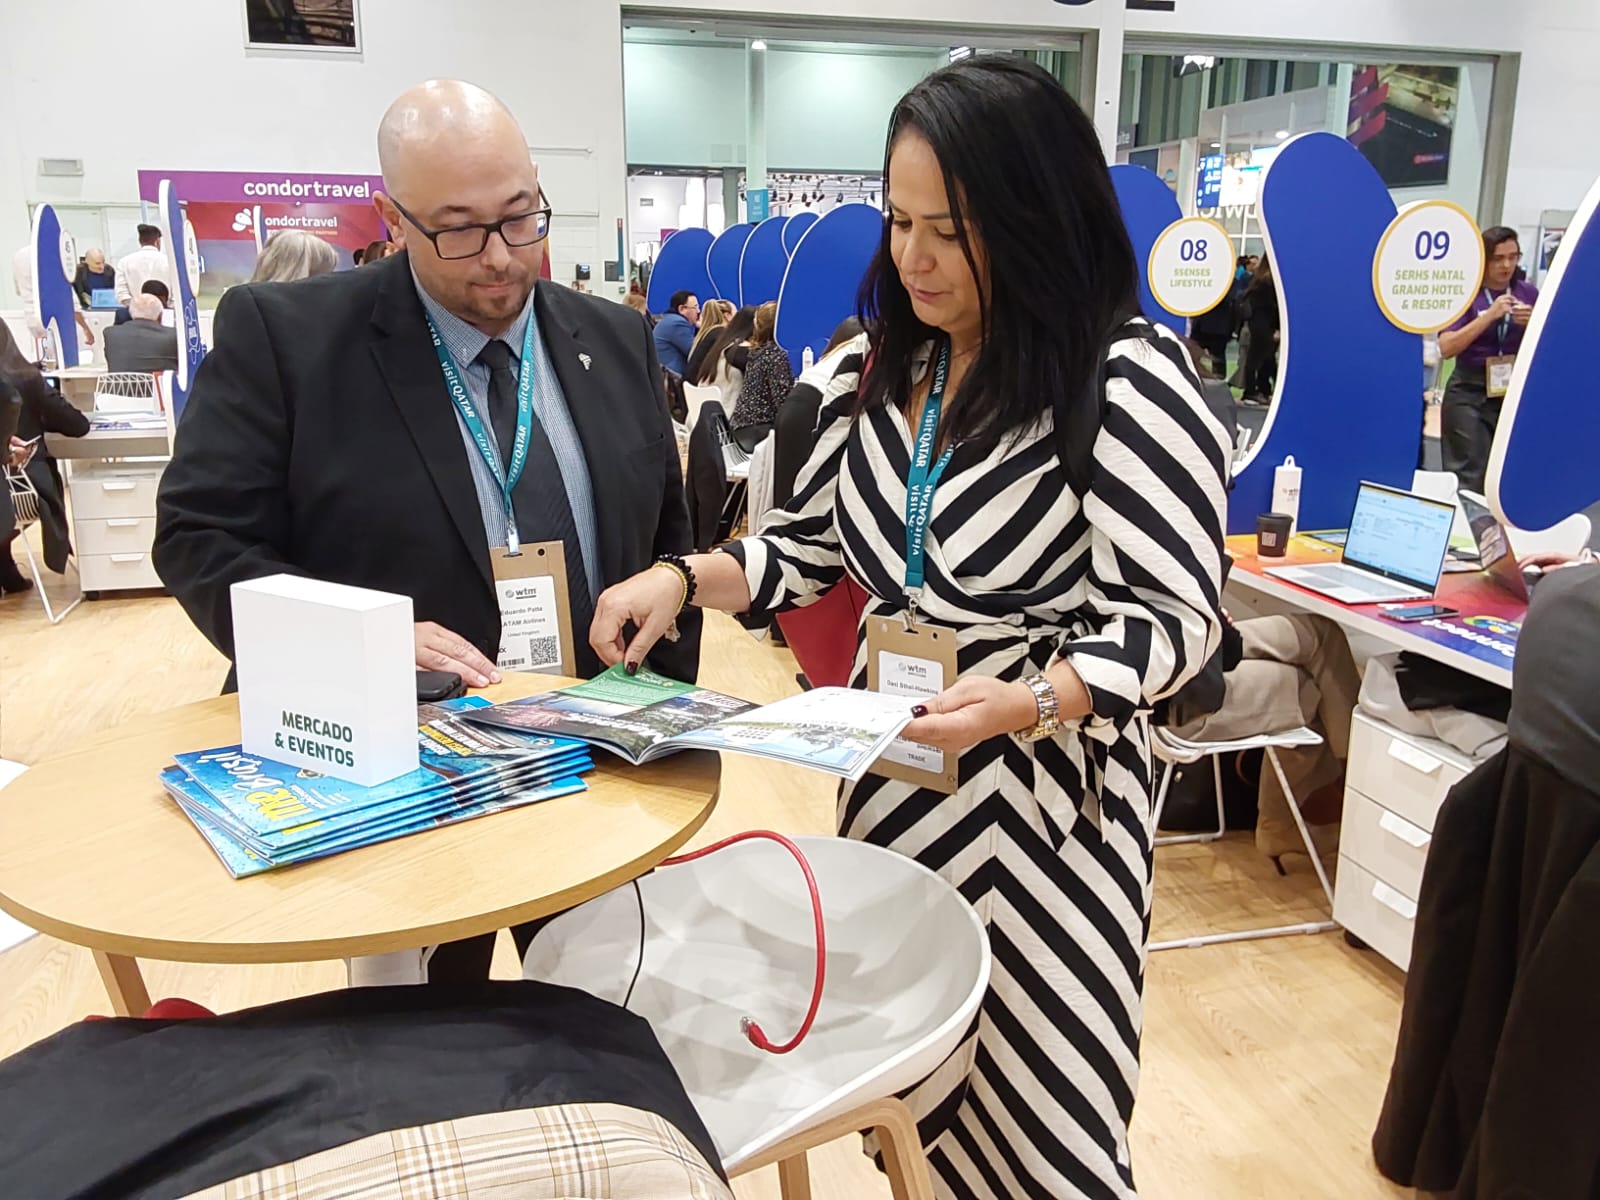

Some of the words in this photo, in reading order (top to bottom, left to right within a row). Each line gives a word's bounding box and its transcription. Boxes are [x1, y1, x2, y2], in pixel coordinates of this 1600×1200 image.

[243, 179, 370, 198] condortravel
[264, 215, 338, 228] ondortravel
[1180, 239, 1208, 262] 08
[1415, 230, 1451, 261] 09
[1395, 269, 1430, 281] SERHS
[1431, 270, 1466, 281] NATAL
[1169, 279, 1214, 288] LIFESTYLE
[1391, 284, 1429, 296] GRAND
[1431, 284, 1465, 296] HOTEL
[1401, 299, 1410, 310] &
[1411, 299, 1454, 310] RESORT
[515, 588, 537, 597] wtm
[502, 619, 522, 627] ATAM
[907, 663, 927, 674] wtm
[282, 709, 353, 743] MERCADO
[274, 731, 285, 749] &
[288, 735, 355, 768] EVENTOS
